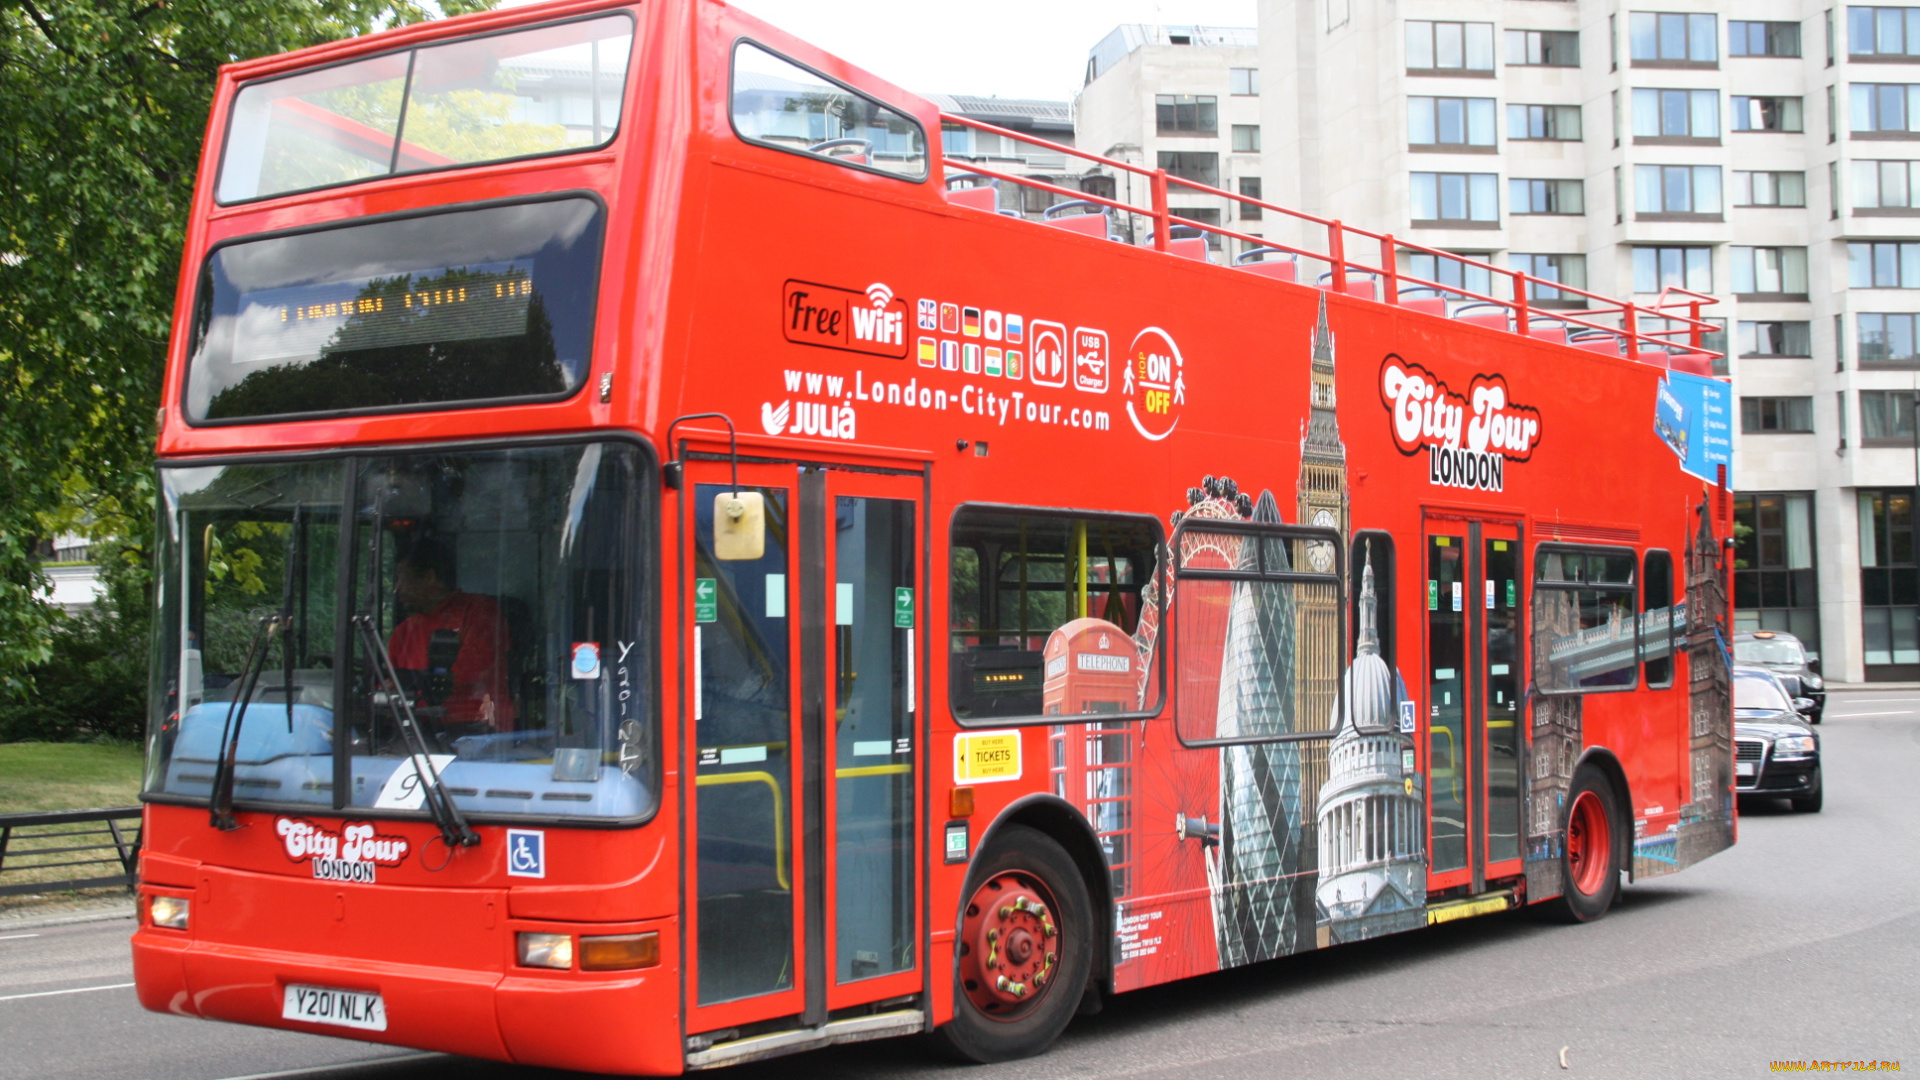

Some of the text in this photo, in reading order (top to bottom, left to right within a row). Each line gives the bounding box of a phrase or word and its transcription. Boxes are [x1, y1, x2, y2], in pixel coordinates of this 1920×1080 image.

[788, 291, 903, 346] Free WiFi
[1082, 335, 1100, 349] USB
[1079, 374, 1104, 388] Charger
[1147, 353, 1171, 383] ON
[784, 370, 1110, 431] www.London-CityTour.com
[1146, 390, 1170, 414] OFF
[1384, 365, 1537, 453] City Tour
[1429, 443, 1503, 492] LONDON
[1080, 654, 1128, 671] TELEPHONE
[976, 750, 1011, 763] TICKETS
[277, 818, 407, 861] City Tour
[312, 857, 376, 883] LONDON
[297, 989, 376, 1022] Y201 NLK
